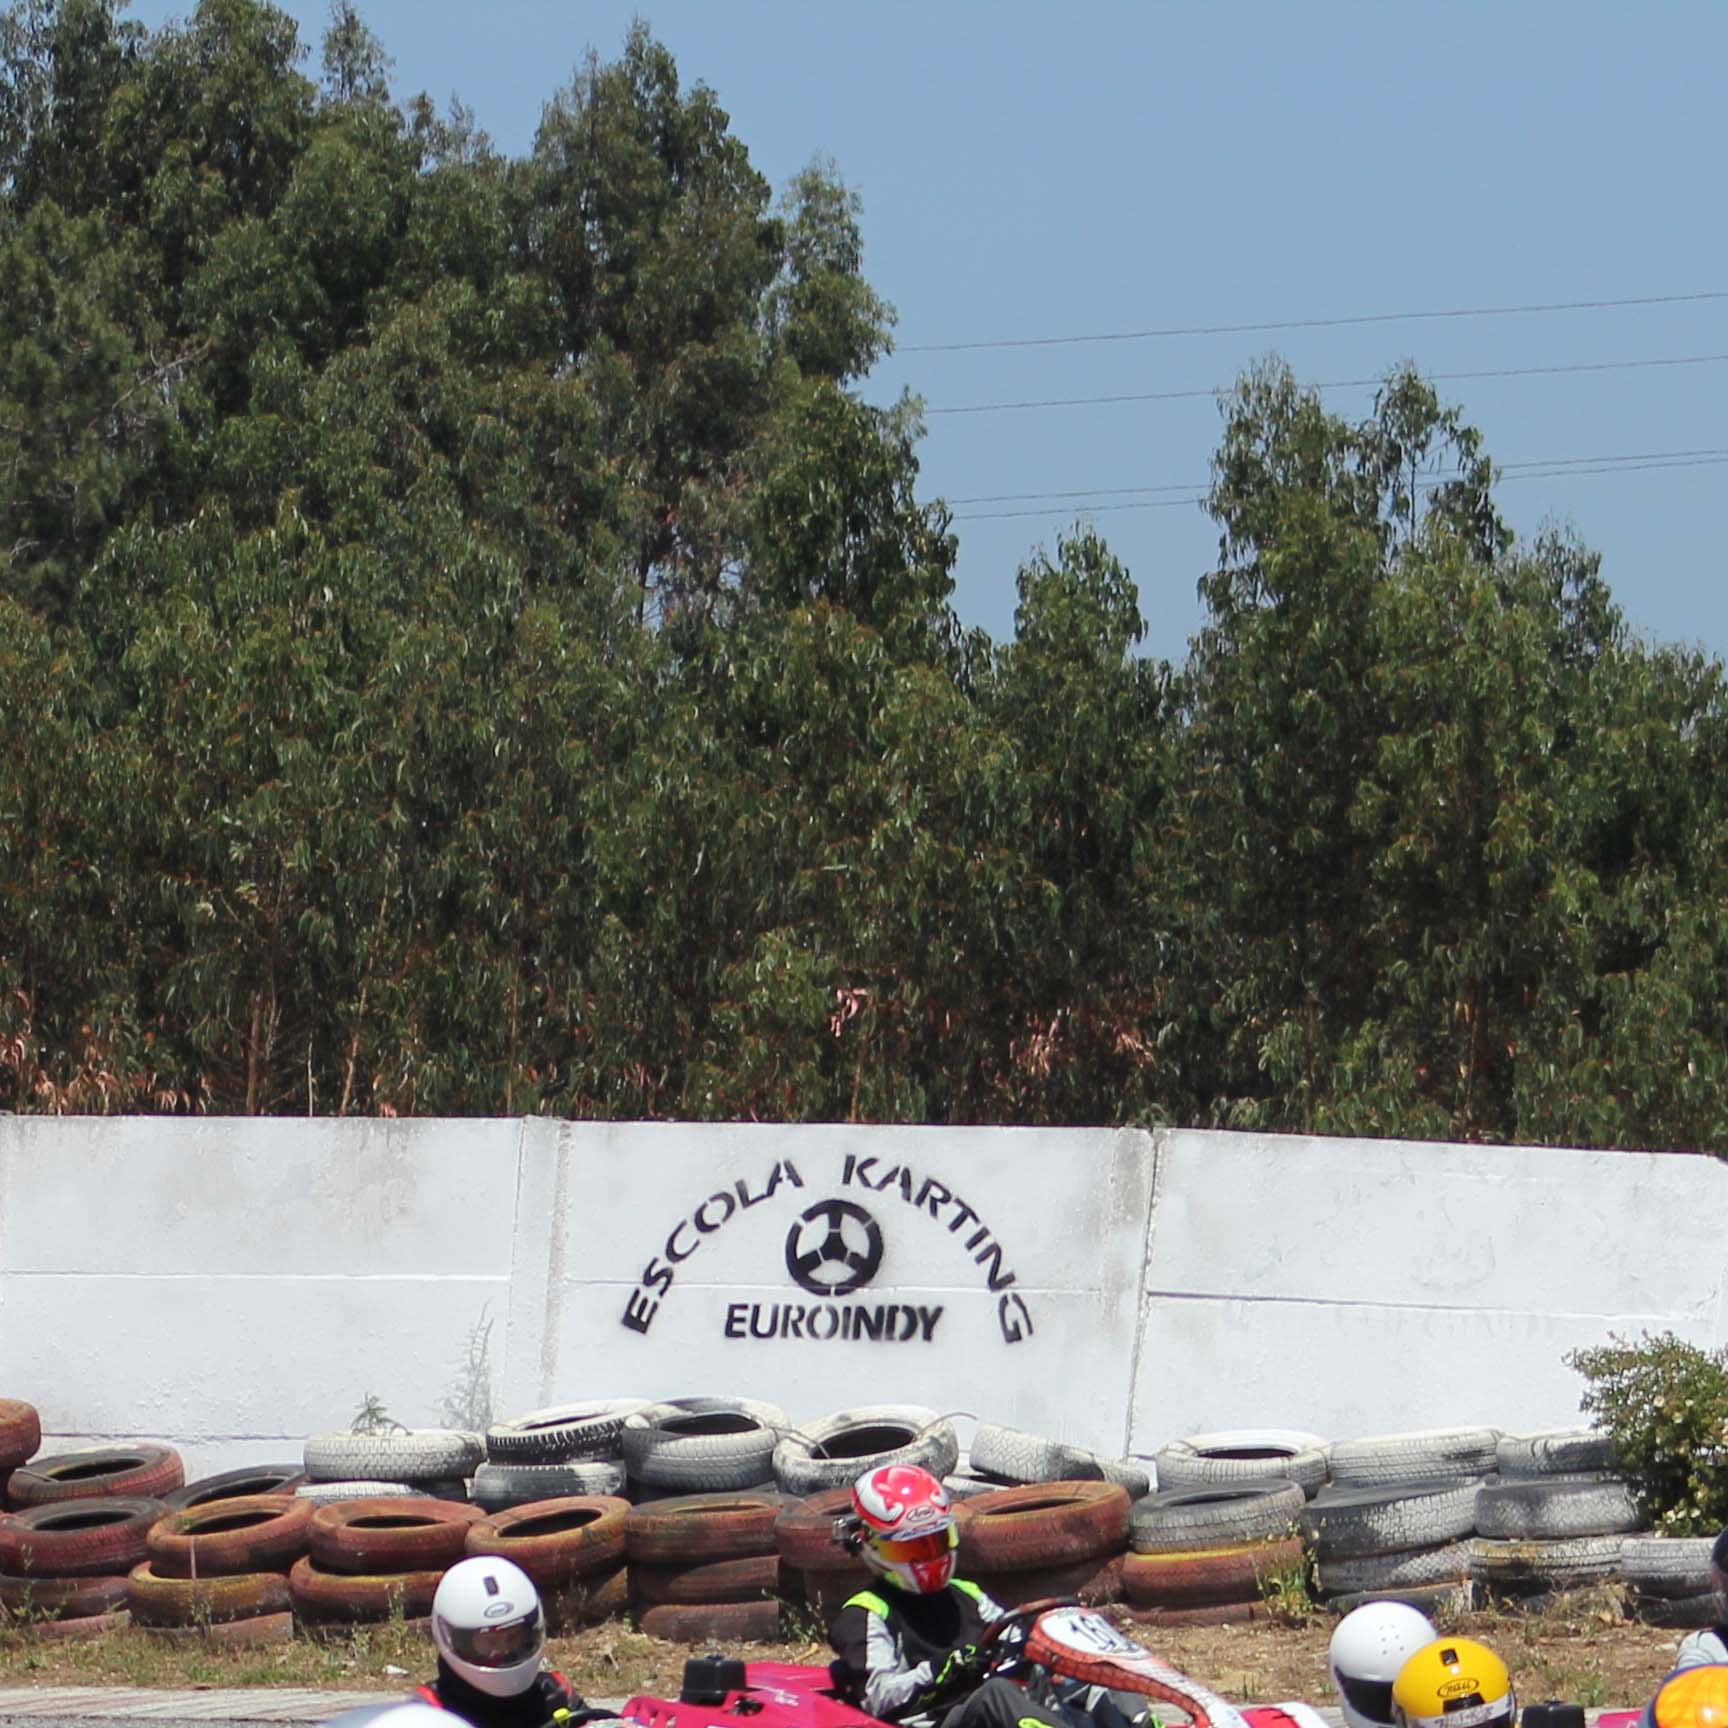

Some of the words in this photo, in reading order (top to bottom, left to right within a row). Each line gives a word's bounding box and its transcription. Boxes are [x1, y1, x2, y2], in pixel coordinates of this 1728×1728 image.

[621, 1159, 804, 1336] ESCOLA
[841, 1154, 1034, 1344] KARTING
[724, 1303, 944, 1342] EUROINDY
